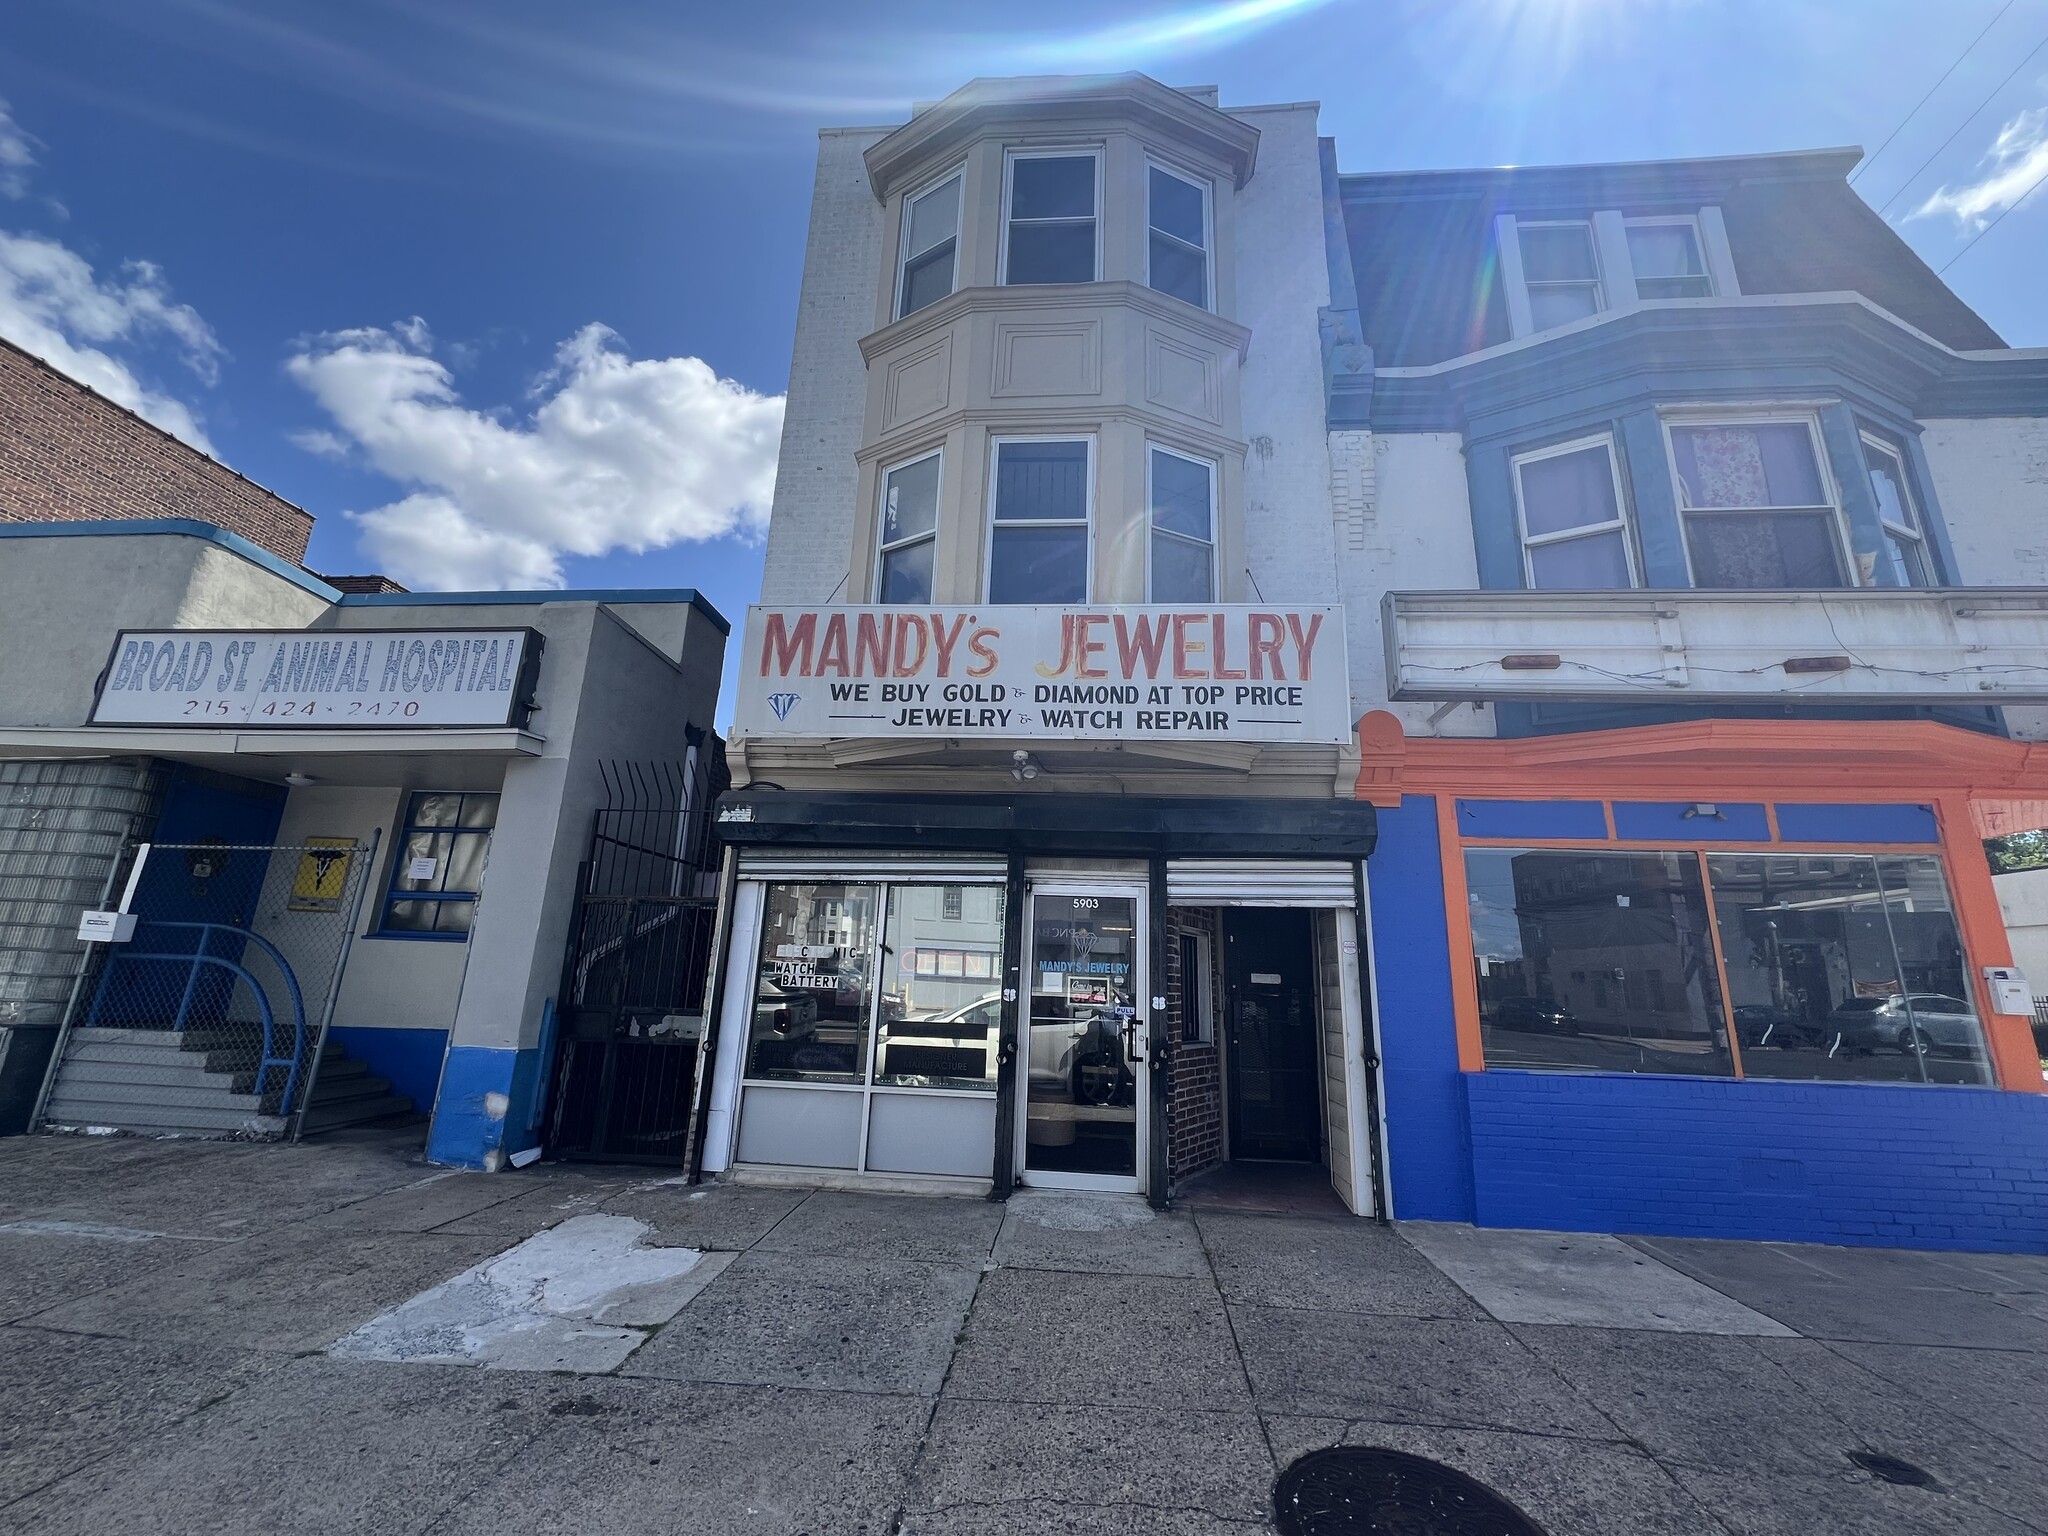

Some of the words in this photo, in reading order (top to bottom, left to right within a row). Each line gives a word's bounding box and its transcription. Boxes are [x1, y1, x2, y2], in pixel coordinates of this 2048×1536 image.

[1034, 613, 1324, 681] JEWELRY
[111, 640, 213, 692] BROAD
[261, 640, 373, 693] ANIMAL
[379, 639, 515, 693] HOSPITAL
[830, 683, 870, 702] WE
[881, 683, 930, 703] BUY
[943, 684, 1007, 703] GOLD
[1034, 684, 1139, 705] DIAMOND
[1147, 686, 1173, 706] AT
[1181, 686, 1225, 706] TOP
[1235, 686, 1303, 707] PRICE
[182, 700, 231, 716] 215
[262, 701, 317, 717] 424
[891, 708, 1013, 728] JEWELRY
[1040, 709, 1123, 729] WATCH
[1136, 710, 1229, 731] REPAIR
[1072, 898, 1100, 909] 5903
[775, 962, 816, 974] WATCH
[1039, 960, 1083, 973] MANDY'S
[1084, 961, 1130, 974] JEWELRY
[782, 975, 838, 987] BATTERY
